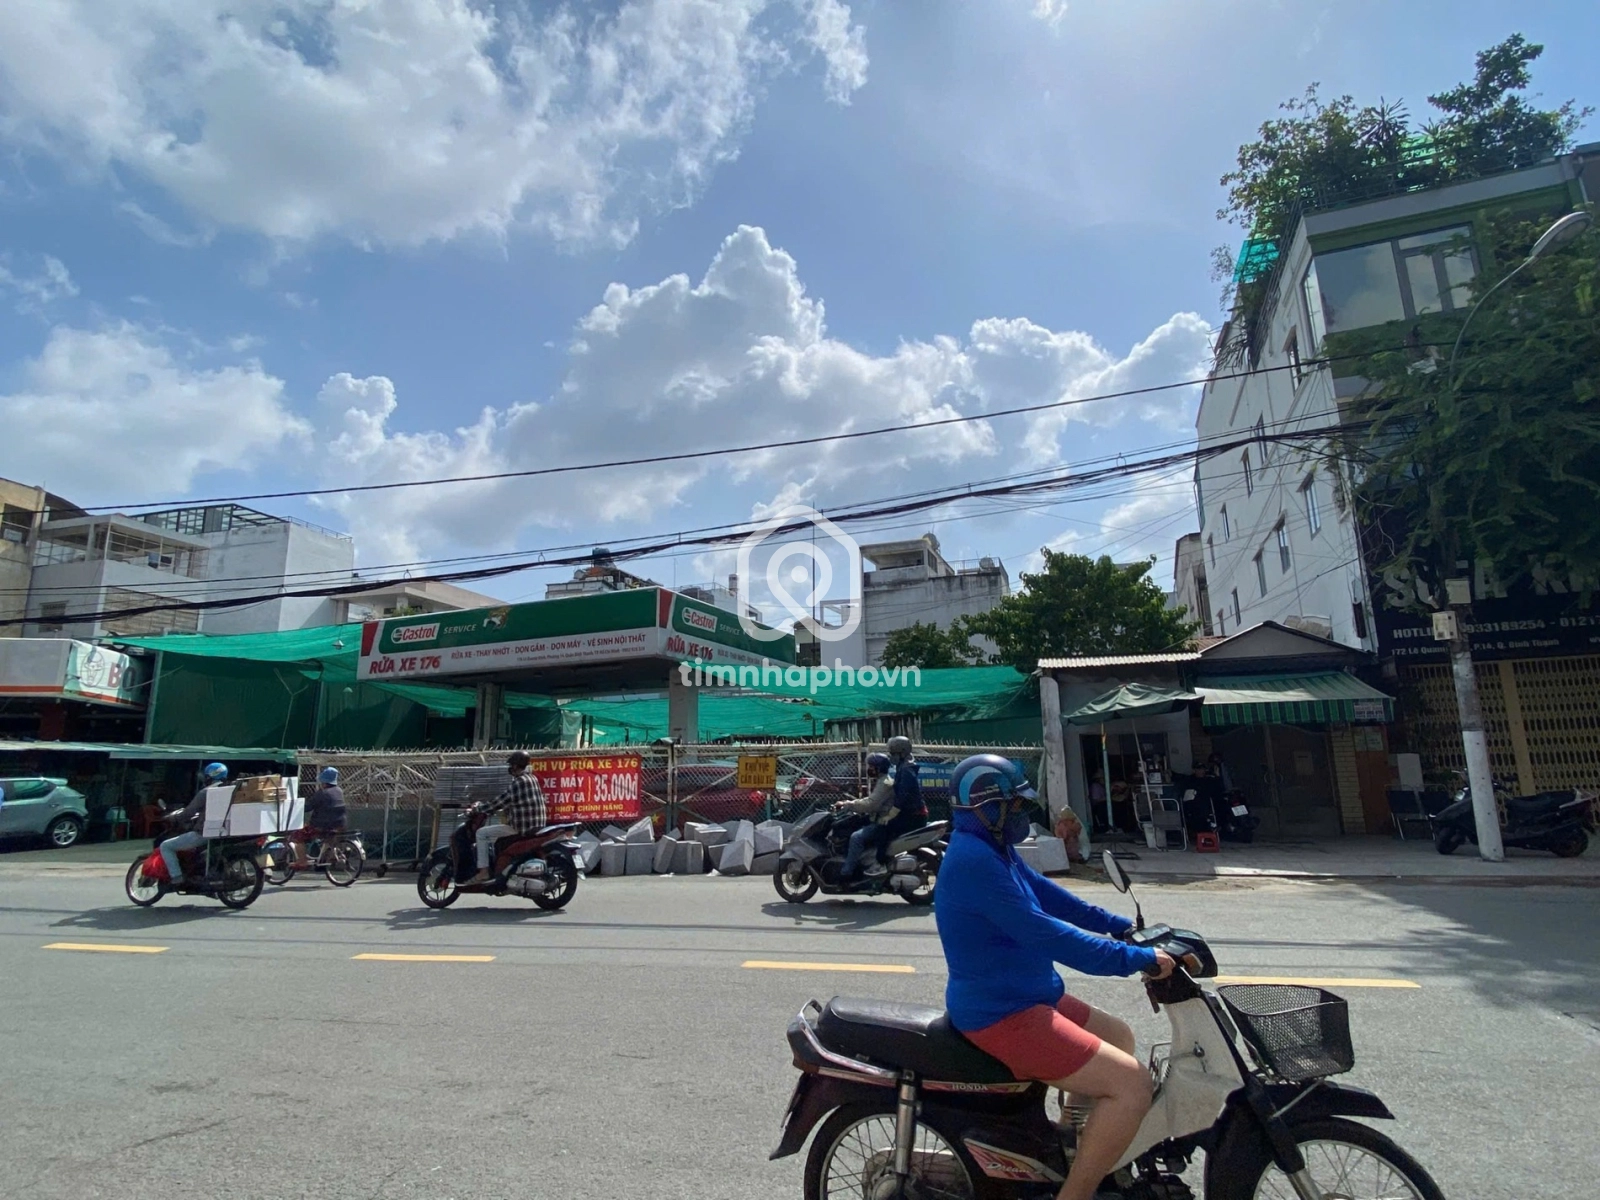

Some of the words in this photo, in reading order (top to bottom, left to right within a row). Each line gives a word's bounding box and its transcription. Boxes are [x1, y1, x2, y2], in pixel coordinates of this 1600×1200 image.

[690, 611, 715, 631] Castrol
[402, 626, 436, 642] Castrol
[443, 624, 477, 635] SERVICE
[719, 623, 741, 636] SERVICE
[464, 651, 472, 659] XE
[476, 649, 491, 657] THAY
[492, 646, 510, 656] NHỚT
[567, 639, 581, 649] MÁY
[597, 637, 613, 647] SINH
[687, 642, 699, 657] XE
[701, 645, 714, 660] 176
[1391, 647, 1407, 656] 172
[369, 656, 395, 674] RỬA
[399, 657, 417, 672] XE
[420, 656, 442, 670] 176
[551, 760, 566, 773] VỤ
[570, 757, 594, 771] RỬA
[597, 759, 613, 769] XE
[617, 758, 639, 769] 176
[543, 777, 557, 789] XE
[560, 774, 585, 788] MÁY
[594, 772, 639, 802] 35.000đ
[553, 792, 571, 804] TAY
[573, 791, 585, 803] GA
[952, 1083, 989, 1091] HONDA
[986, 1161, 1031, 1174] Dream
